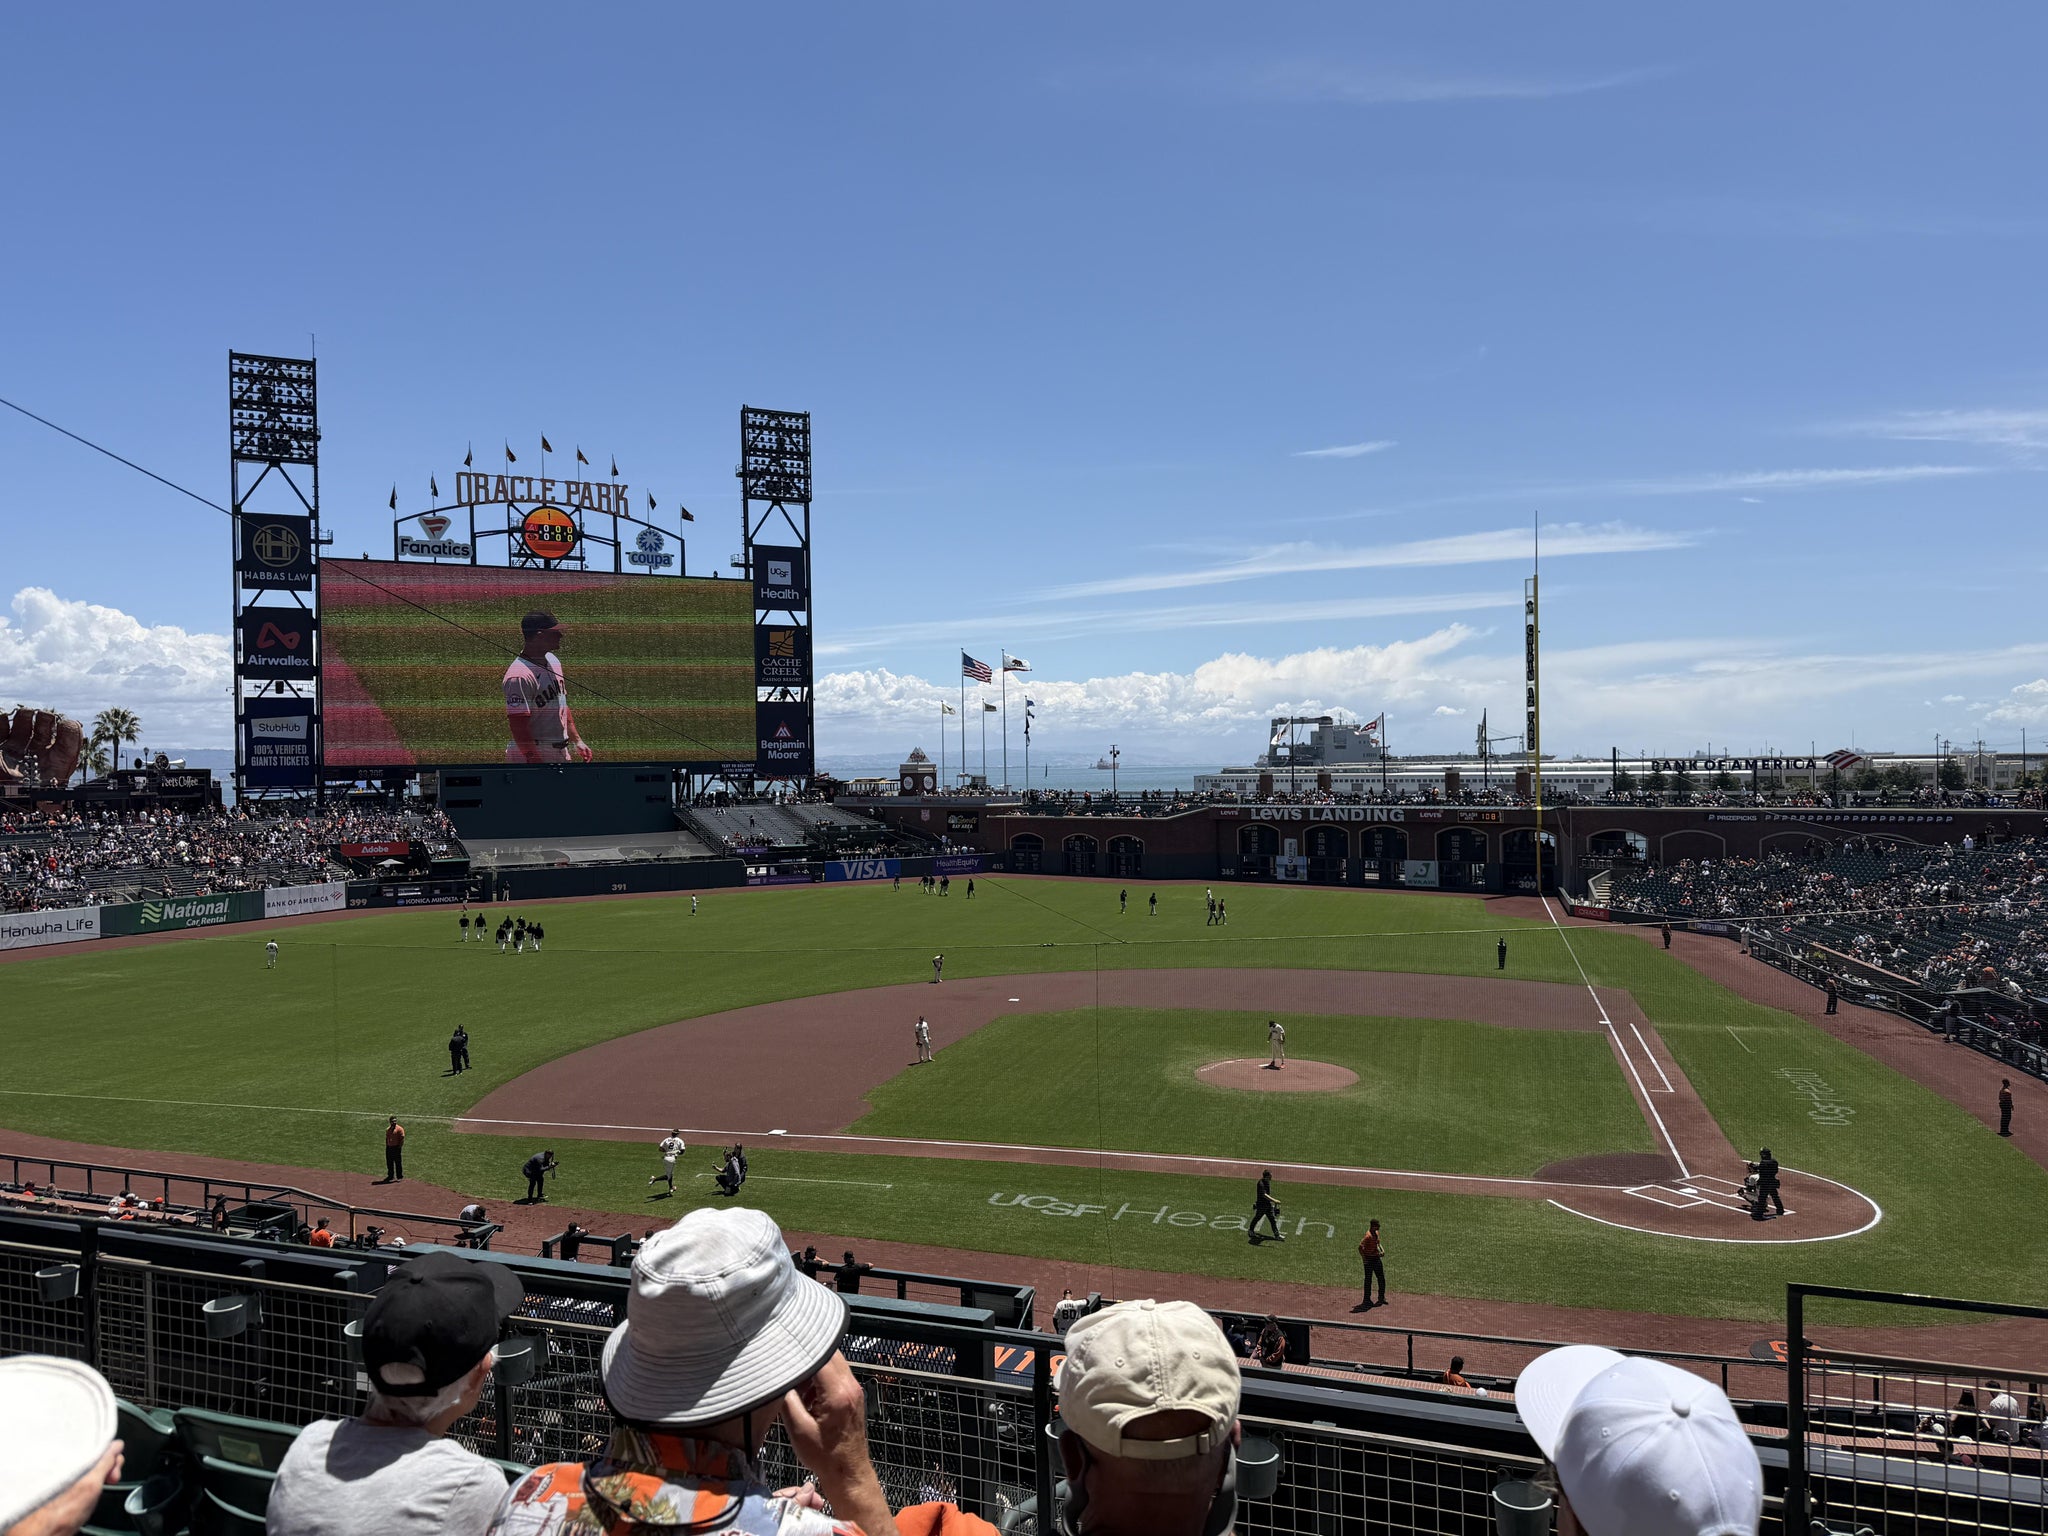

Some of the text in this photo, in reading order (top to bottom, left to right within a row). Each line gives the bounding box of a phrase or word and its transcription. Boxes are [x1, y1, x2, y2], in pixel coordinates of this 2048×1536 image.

[456, 472, 630, 519] ORACLE PARK
[401, 538, 470, 556] Fanatics
[631, 553, 670, 568] coupa
[244, 571, 309, 582] HABBAS LAW
[770, 568, 789, 578] UCSF
[760, 588, 799, 600] Health
[248, 654, 310, 666] Airwallex
[762, 658, 802, 667] CACHE
[763, 667, 800, 676] CREEK
[258, 723, 300, 732] StubHub
[253, 745, 307, 755] 100% VERIFIED
[761, 740, 805, 751] Benjamin
[768, 750, 799, 759] Moore
[251, 756, 310, 767] GIANTS TICKETS
[1652, 758, 1817, 770] BANK OF AMERICA
[1309, 808, 1405, 822] LANDING
[1481, 812, 1496, 820] 108
[361, 846, 389, 854] Adobe
[841, 861, 887, 879] VISA
[611, 883, 627, 891] 391
[1518, 881, 1536, 889] 309
[298, 895, 328, 905] AMERICA
[349, 898, 368, 907] 399
[431, 896, 458, 904] MINOLTA
[163, 898, 229, 920] National
[186, 915, 226, 926] Car Rental
[1, 918, 94, 938] Hanwha Life
[988, 1192, 1335, 1239] UCSF Heath
[1062, 1310, 1076, 1319] 80
